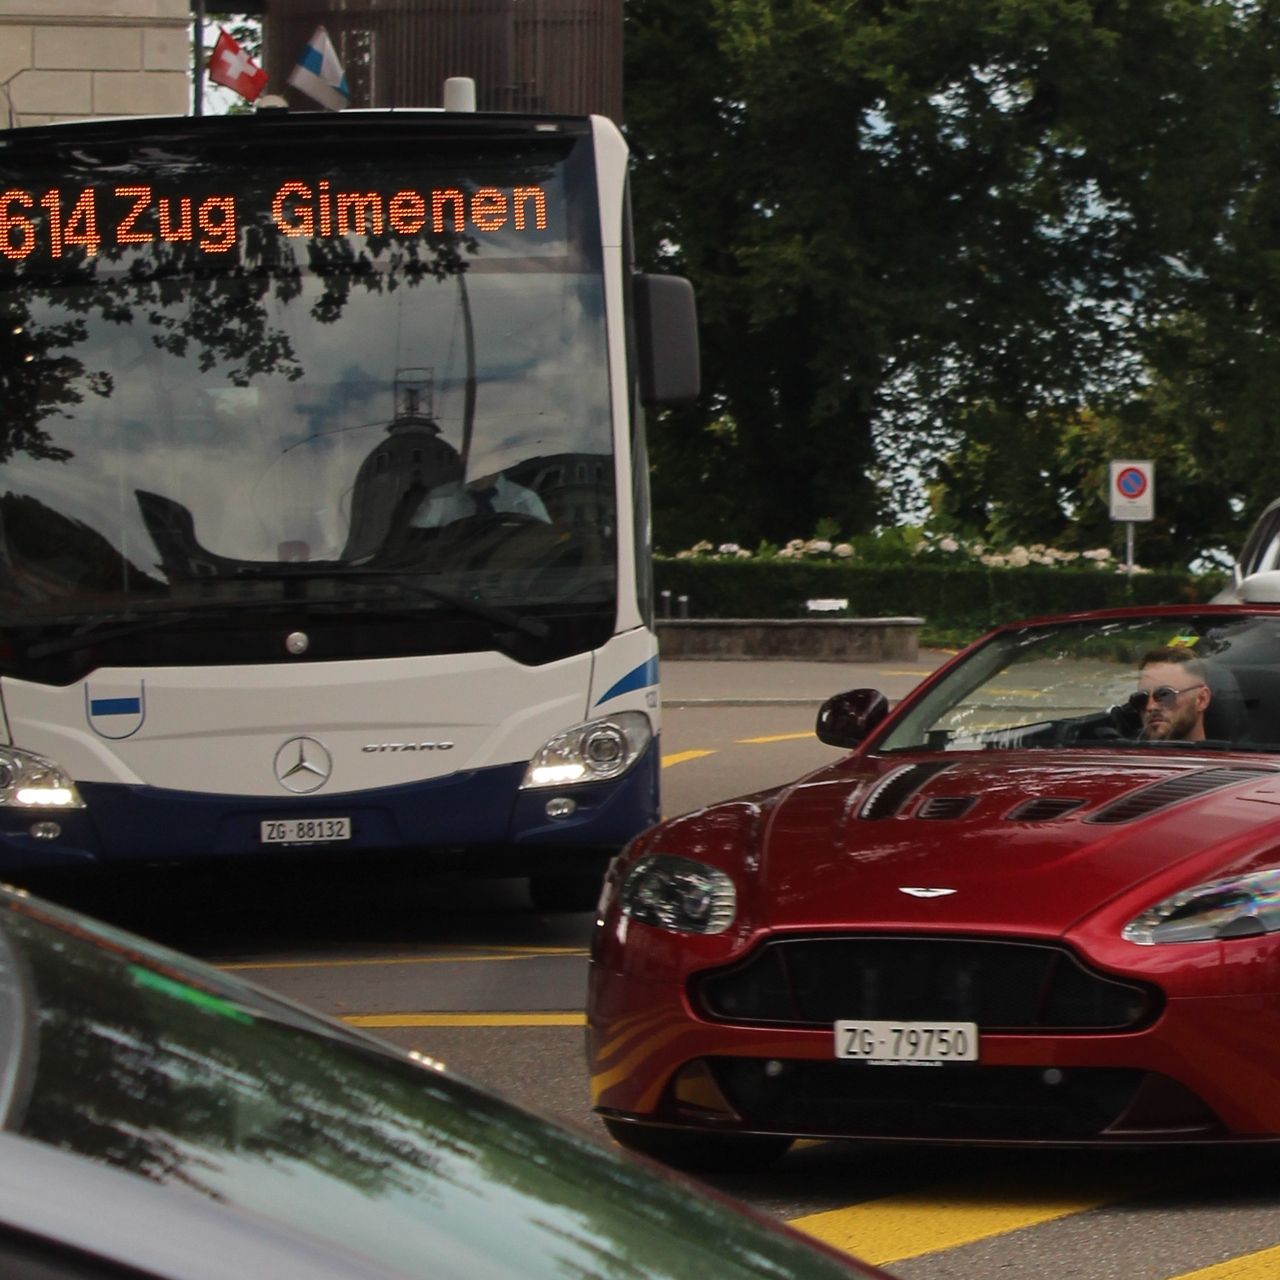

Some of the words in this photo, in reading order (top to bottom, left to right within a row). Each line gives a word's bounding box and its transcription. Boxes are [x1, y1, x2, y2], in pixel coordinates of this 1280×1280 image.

[0, 188, 101, 259] 614
[114, 184, 237, 254] Zug
[271, 179, 548, 238] Gimenen
